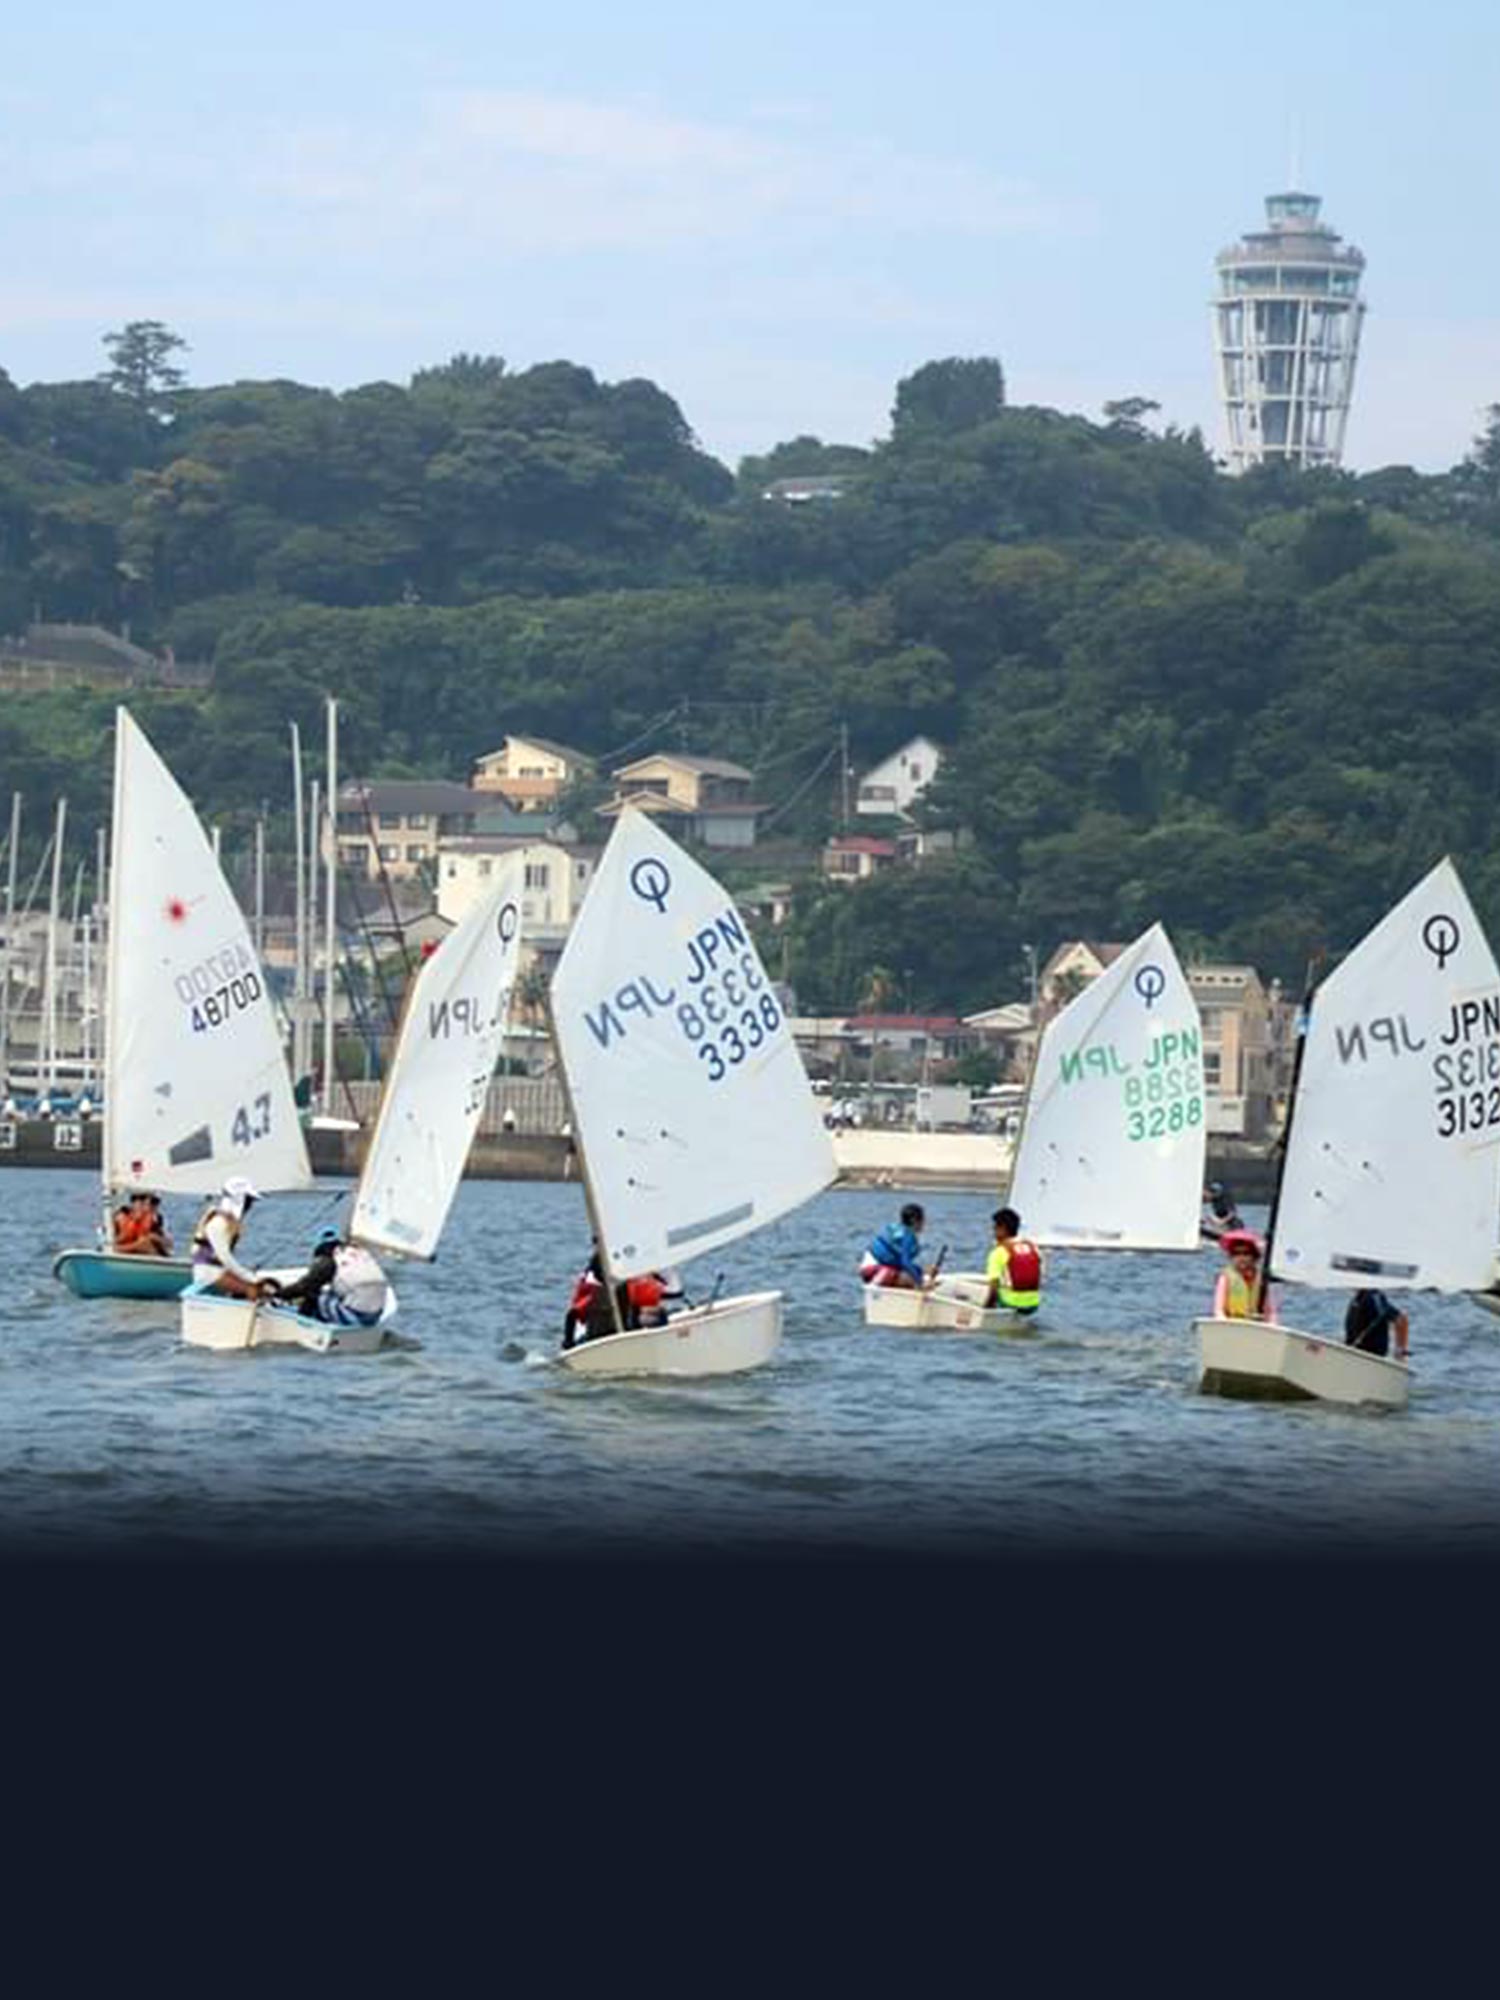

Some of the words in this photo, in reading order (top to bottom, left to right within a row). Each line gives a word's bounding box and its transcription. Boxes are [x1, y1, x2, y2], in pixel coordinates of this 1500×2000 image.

[687, 909, 747, 984] JPN
[192, 972, 261, 1032] 48700
[1440, 996, 1500, 1046] JPN
[699, 993, 780, 1081] 3338
[1143, 1025, 1198, 1068] JPN
[231, 1091, 271, 1146] 4.7
[1128, 1096, 1202, 1141] 3288
[1438, 1086, 1500, 1138] 3132
